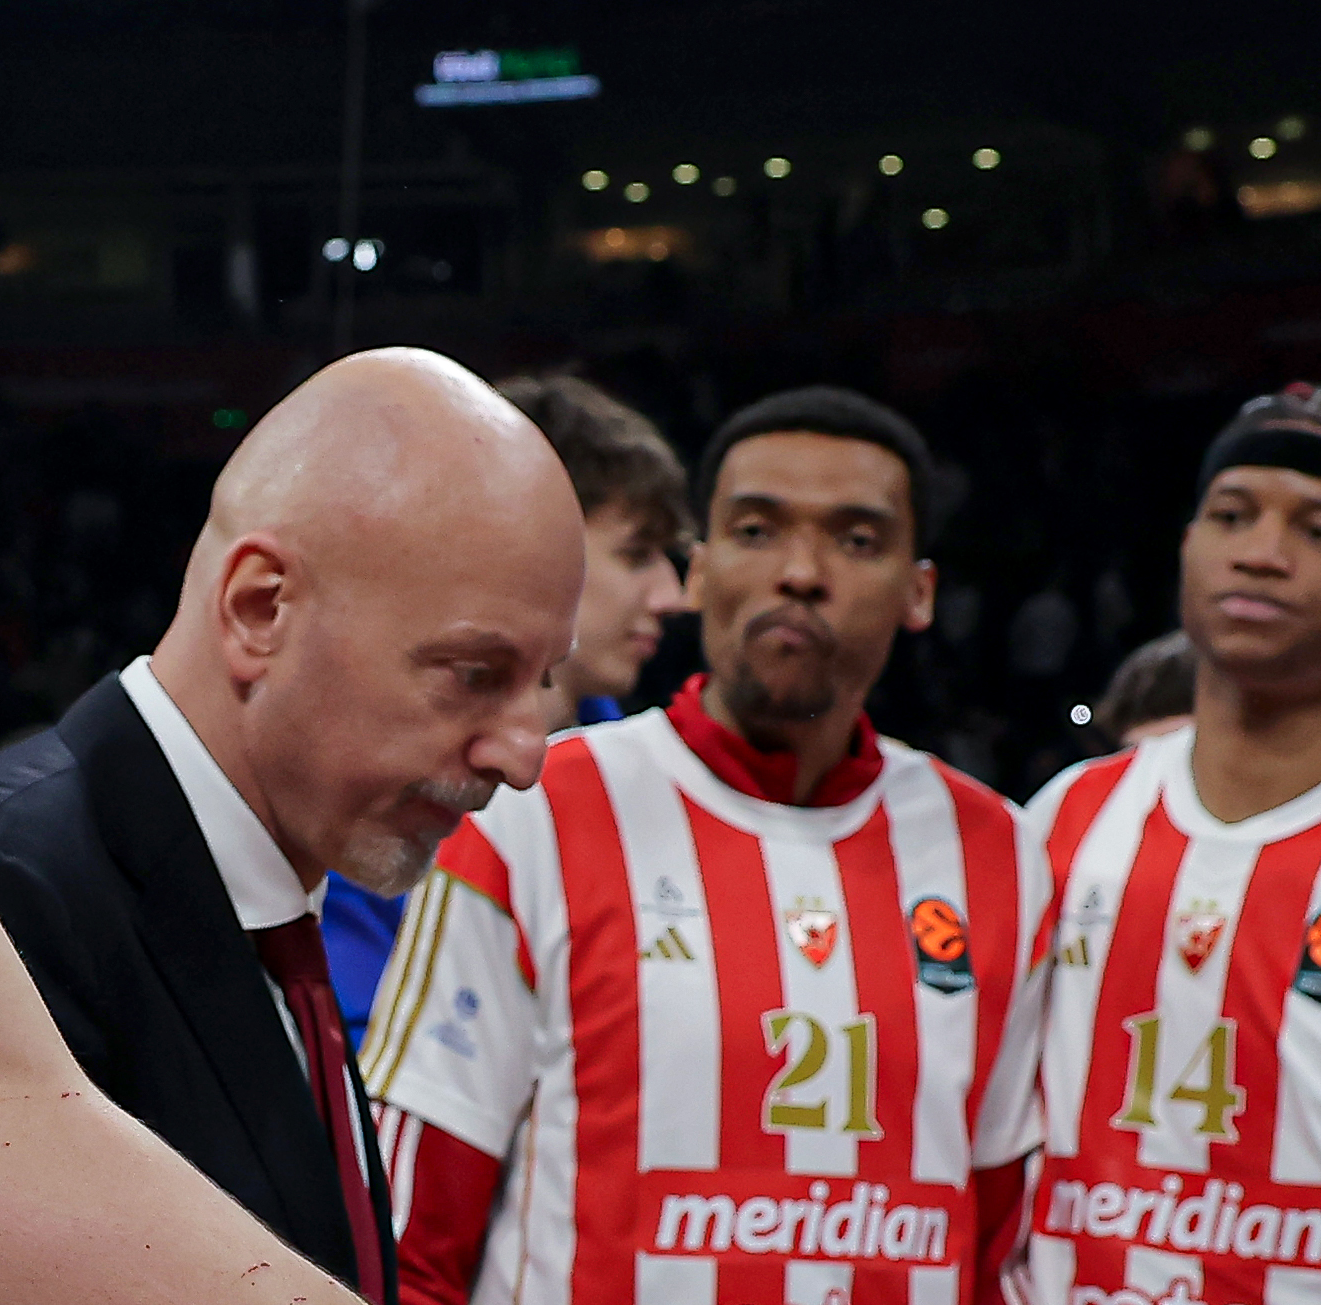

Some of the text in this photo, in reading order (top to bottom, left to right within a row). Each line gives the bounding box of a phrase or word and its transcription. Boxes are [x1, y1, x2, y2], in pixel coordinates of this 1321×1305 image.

[762, 1010, 883, 1139] 21
[1111, 1011, 1246, 1144] 14
[655, 1180, 949, 1261] meridian
